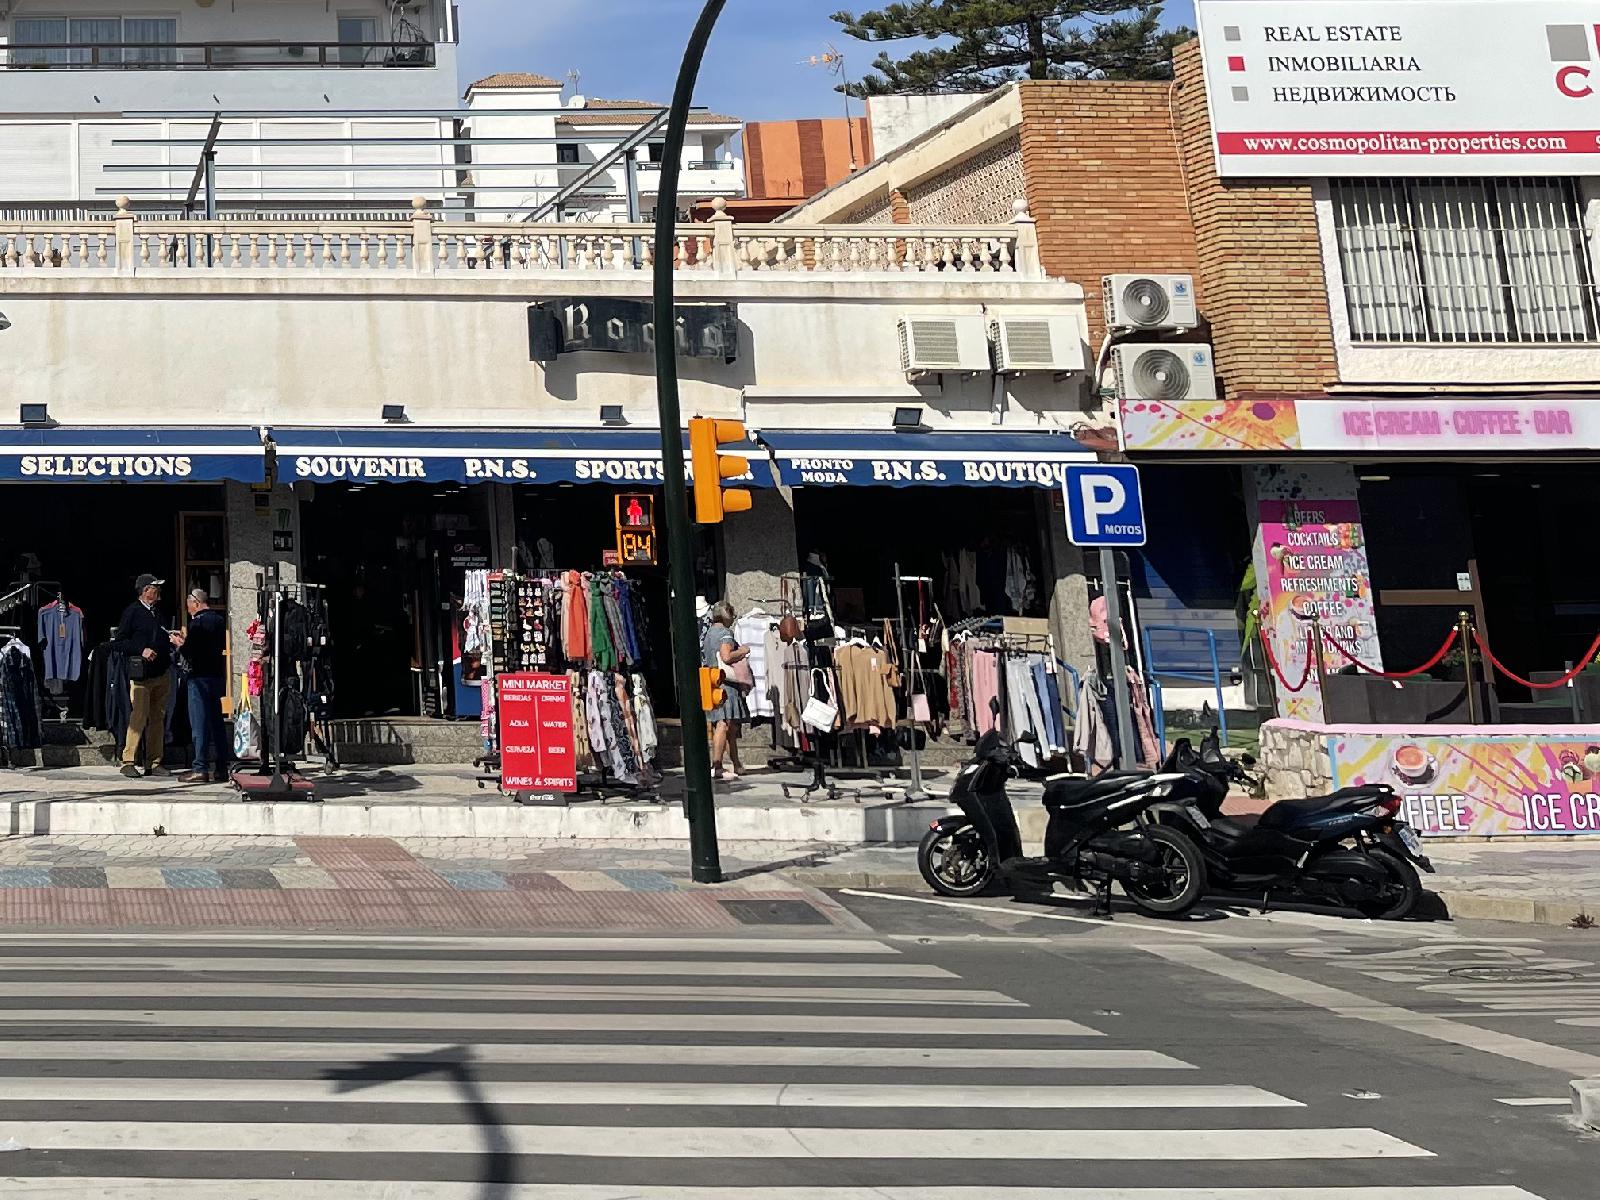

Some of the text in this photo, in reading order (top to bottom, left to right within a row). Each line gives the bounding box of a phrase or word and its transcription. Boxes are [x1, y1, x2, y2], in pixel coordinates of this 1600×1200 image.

[1264, 25, 1403, 43] REAL ESTATE
[1268, 55, 1422, 73] INMOBILIARIA
[1272, 85, 1457, 105] НЕДВИЖИМОСТЬ
[1243, 132, 1568, 154] www.cosmopolitan-properties.com
[1343, 411, 1573, 436] ICE CREAM COFFEE BAR
[20, 456, 192, 477] SELECTIONS
[295, 456, 427, 478] SOUVENIR
[464, 458, 537, 478] P.N.S.
[791, 458, 854, 471] PRONTO
[872, 460, 947, 481] P.N.S.
[801, 471, 849, 484] MODA
[1079, 474, 1126, 535] P
[1294, 510, 1326, 524] BEERS
[1104, 523, 1142, 535] MOTOS
[1287, 532, 1339, 547] COCKTAILS
[1289, 555, 1345, 570] ICE CREAM
[1280, 578, 1359, 593] REFRESHMENTS
[1302, 601, 1343, 616] COFFEE
[1335, 625, 1355, 639] AND
[502, 679, 568, 690] MINI MARKET
[548, 746, 566, 754] BEER
[505, 776, 533, 786] WINES
[543, 777, 574, 787] SPIRITS
[1400, 795, 1470, 831] FFEE
[1522, 794, 1567, 831] ICE
